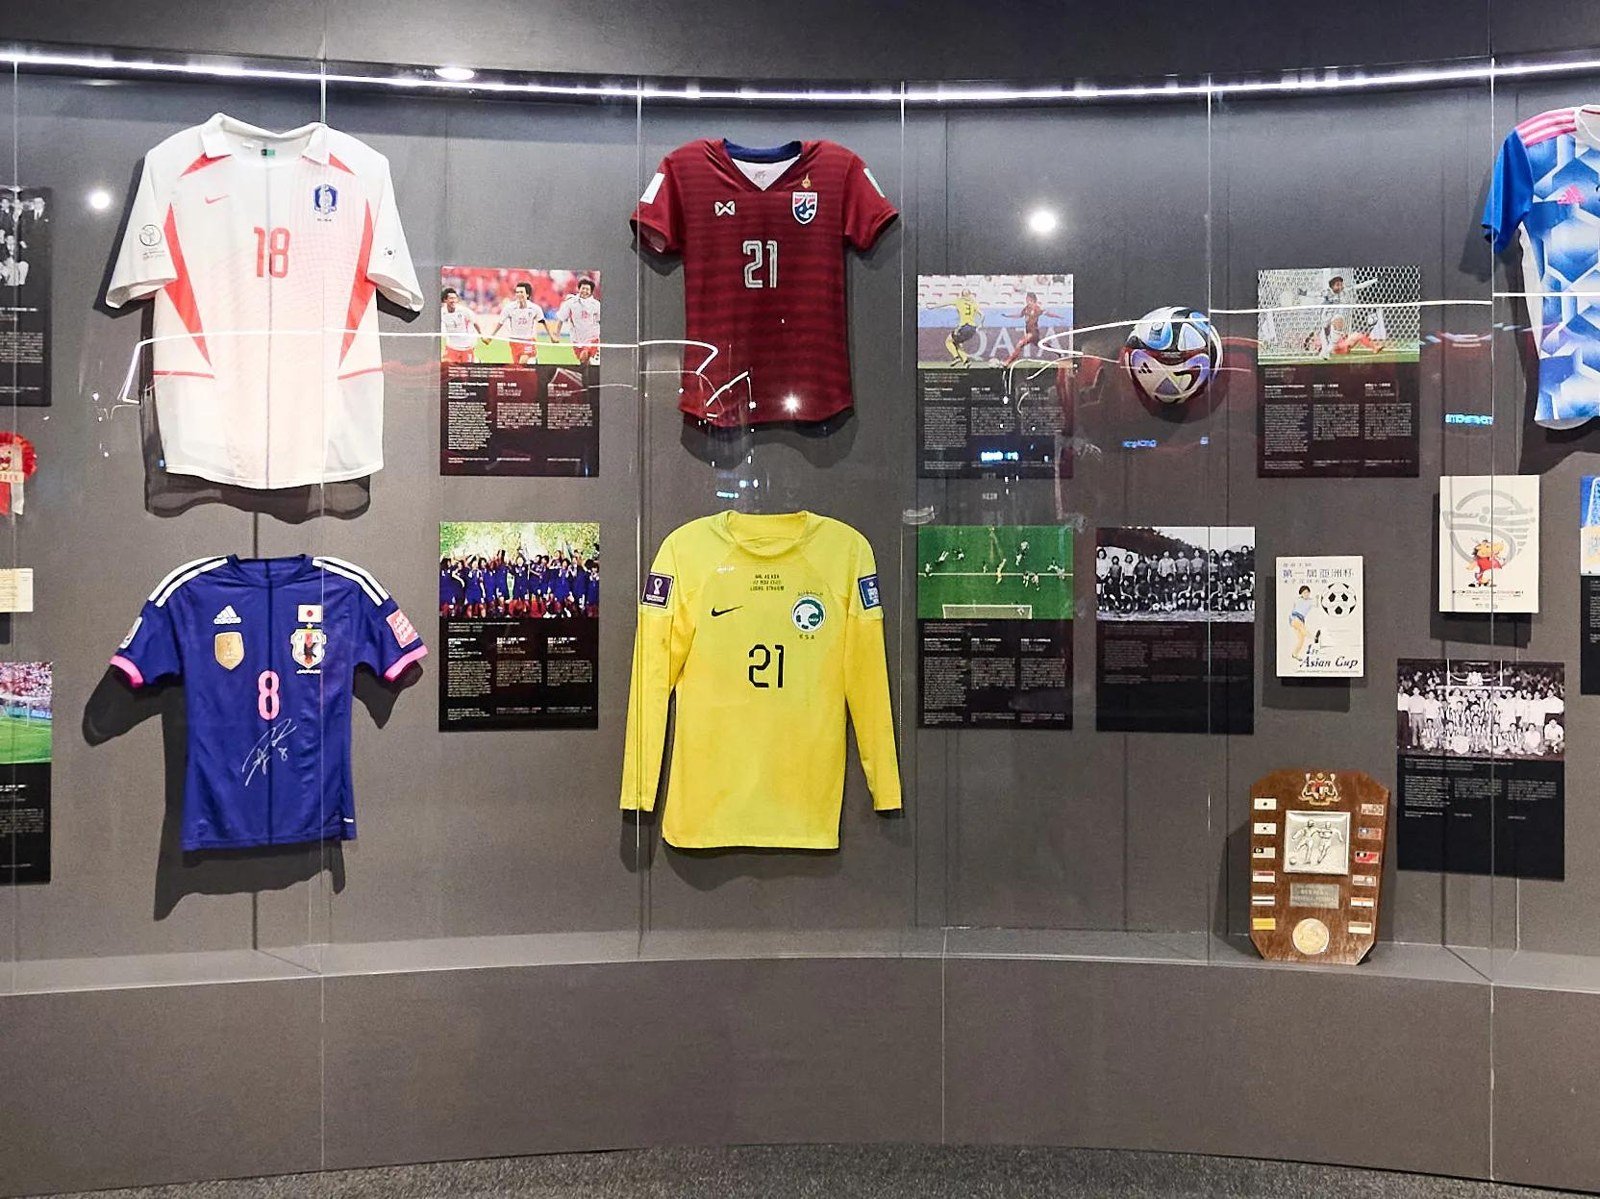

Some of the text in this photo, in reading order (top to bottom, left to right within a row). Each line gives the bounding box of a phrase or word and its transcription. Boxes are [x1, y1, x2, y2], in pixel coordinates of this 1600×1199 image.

[253, 226, 290, 278] 18
[742, 240, 778, 289] 21
[748, 644, 784, 688] 21
[1300, 656, 1358, 668] Asian Cup
[258, 670, 280, 720] 8
